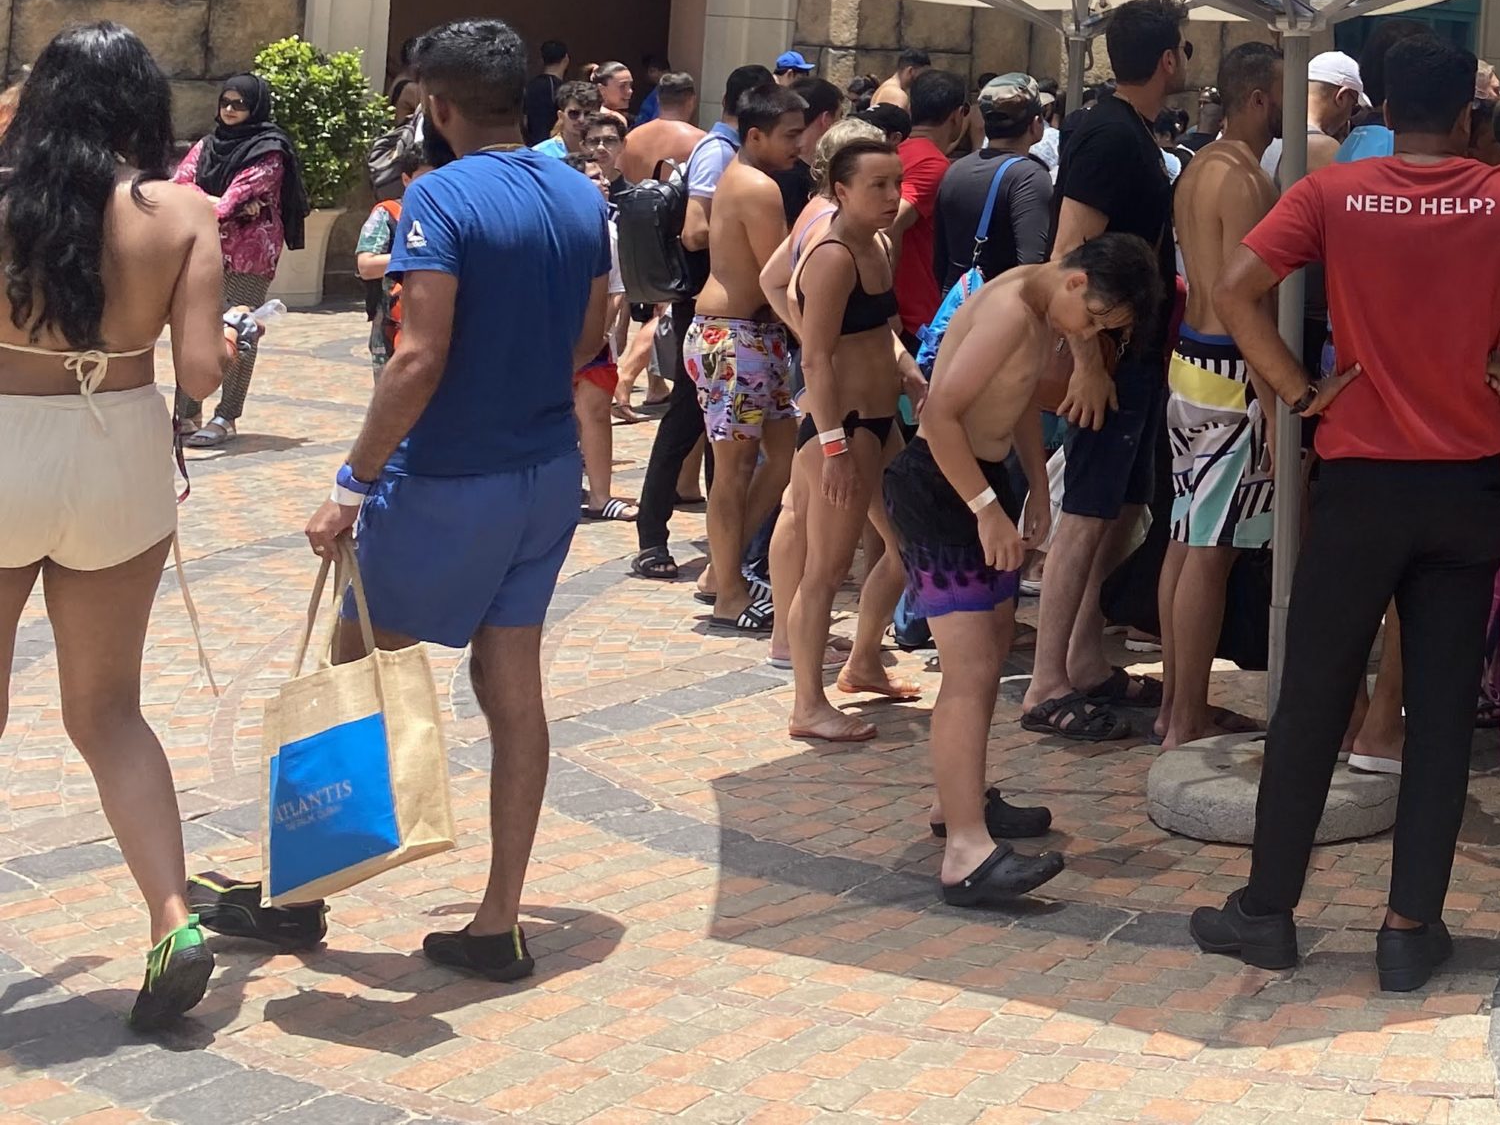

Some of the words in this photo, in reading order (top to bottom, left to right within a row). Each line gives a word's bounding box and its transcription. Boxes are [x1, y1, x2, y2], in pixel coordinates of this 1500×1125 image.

[1345, 194, 1412, 214] NEED
[1420, 197, 1496, 215] HELP?
[275, 779, 353, 824] ATLANTIS
